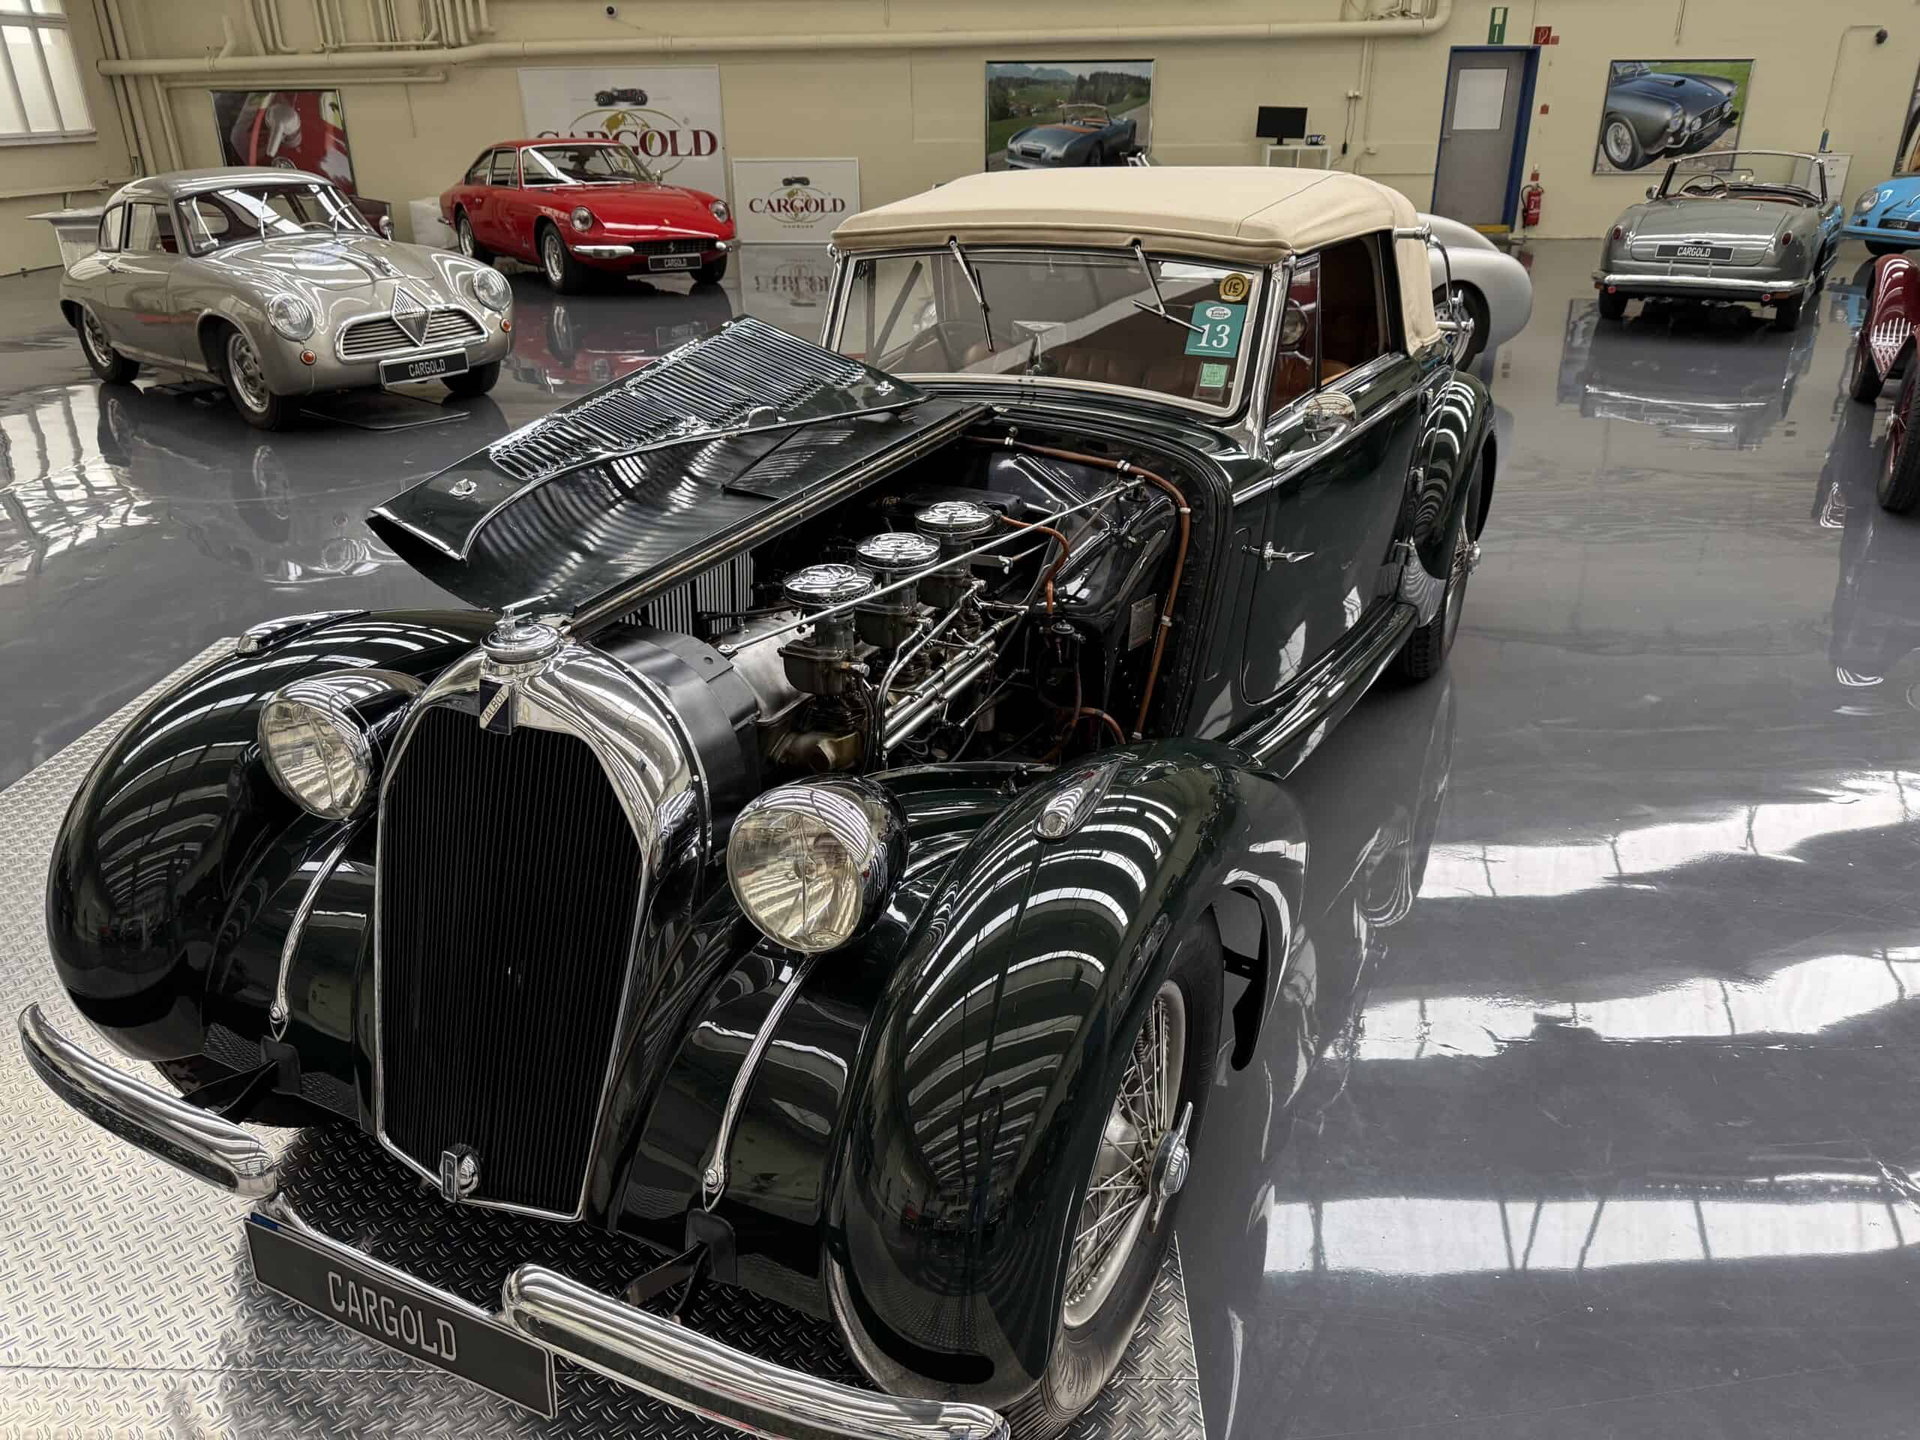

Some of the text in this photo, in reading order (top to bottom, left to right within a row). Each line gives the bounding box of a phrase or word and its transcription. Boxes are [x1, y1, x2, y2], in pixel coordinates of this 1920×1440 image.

[537, 129, 718, 157] GOLD
[748, 198, 846, 214] CARGOLD
[1677, 246, 1711, 257] CARGOLD
[1196, 323, 1231, 348] 13
[408, 359, 446, 377] CARGOLD
[482, 690, 507, 722] TALBOT
[328, 1271, 457, 1361] CARGOLD
